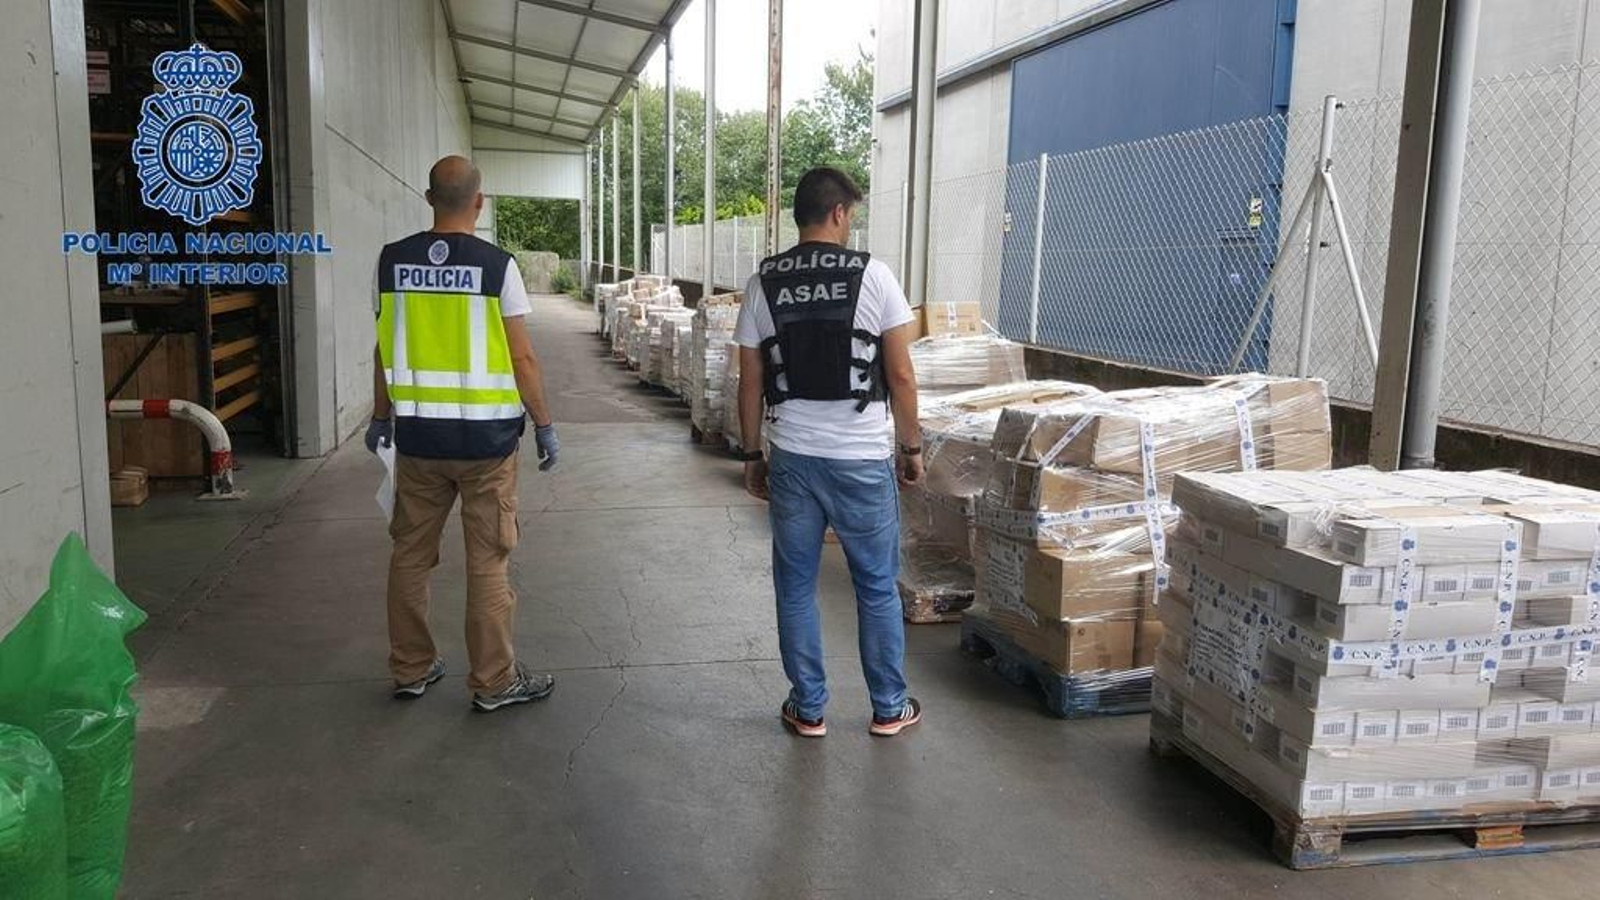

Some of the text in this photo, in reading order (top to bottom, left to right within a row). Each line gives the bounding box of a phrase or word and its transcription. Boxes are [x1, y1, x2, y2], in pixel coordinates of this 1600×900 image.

[760, 250, 865, 275] POLÍCIA
[399, 267, 474, 289] POLICIA
[776, 281, 848, 306] ASAE
